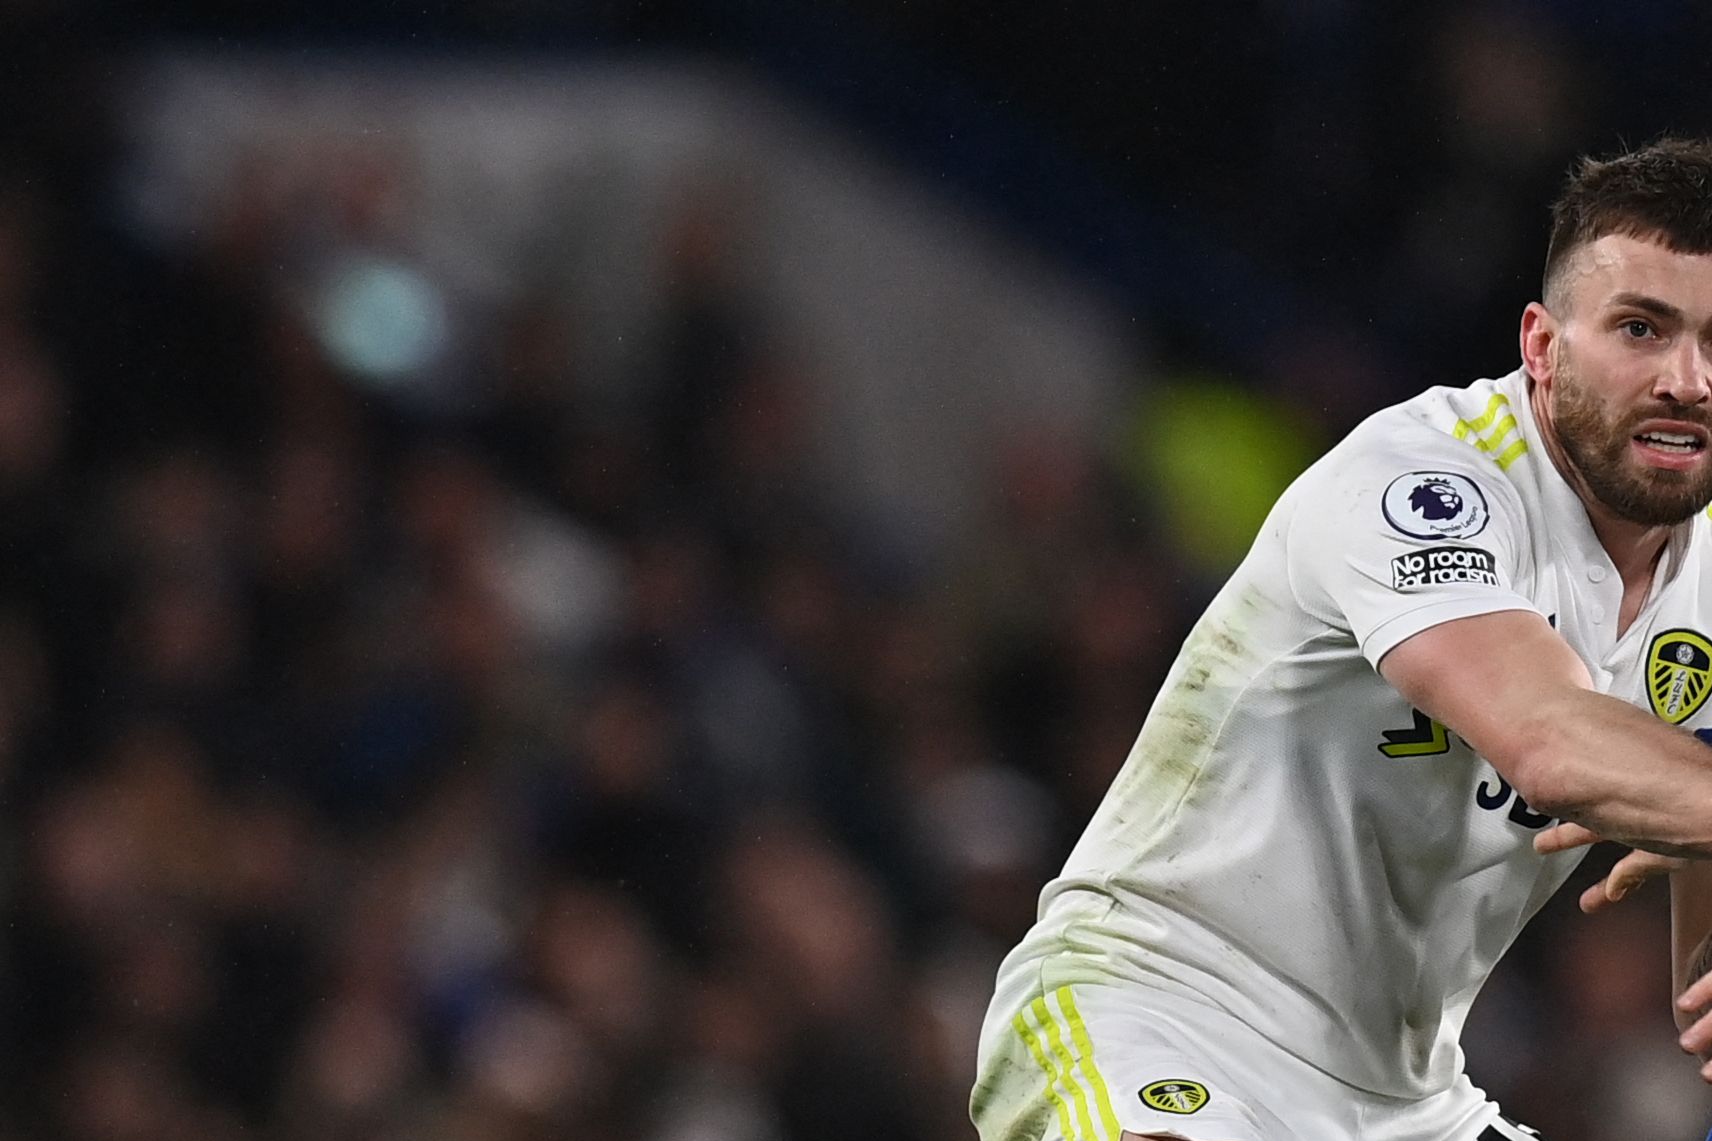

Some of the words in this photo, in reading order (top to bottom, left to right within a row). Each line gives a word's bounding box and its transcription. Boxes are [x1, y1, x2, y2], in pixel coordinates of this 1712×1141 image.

[1393, 555, 1425, 576] No
[1428, 551, 1488, 569] room
[1429, 568, 1497, 587] racism
